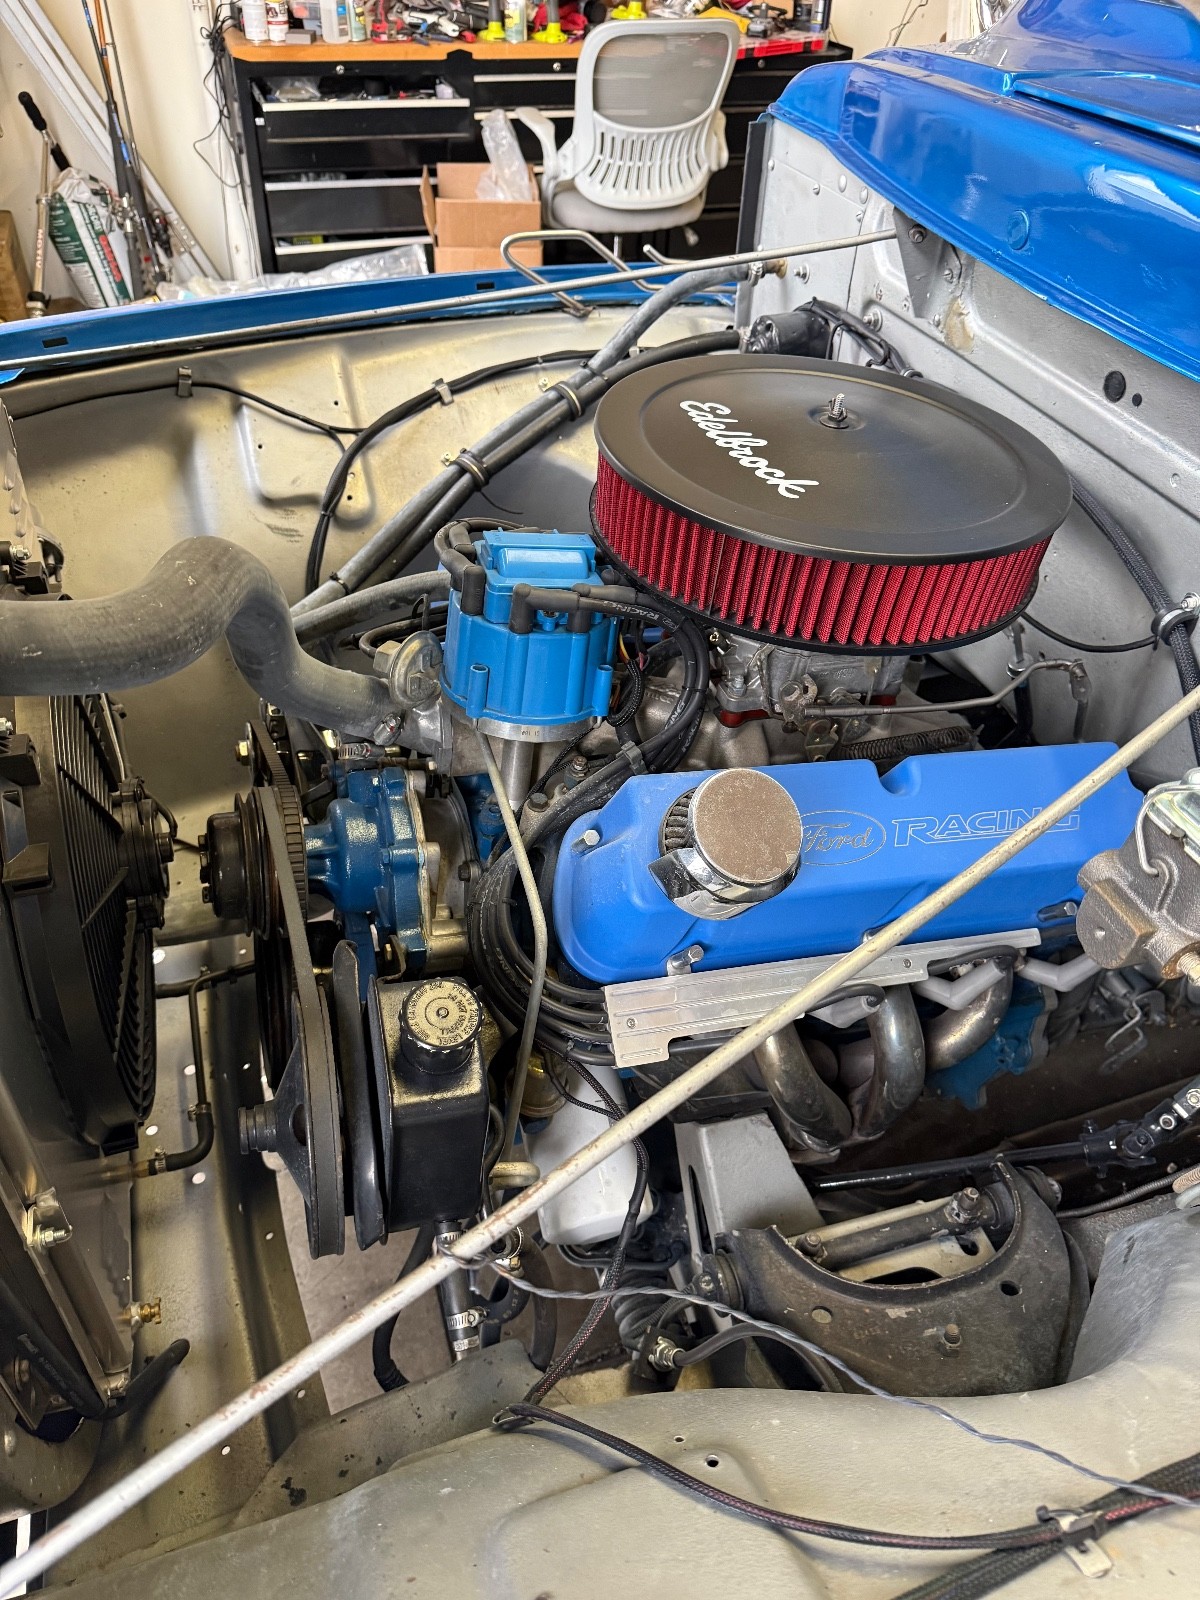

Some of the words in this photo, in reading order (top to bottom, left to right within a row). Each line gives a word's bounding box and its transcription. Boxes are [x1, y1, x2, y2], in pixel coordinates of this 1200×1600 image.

[680, 401, 819, 498] Edelbrock
[603, 600, 660, 621] RACING
[802, 822, 874, 852] Ford
